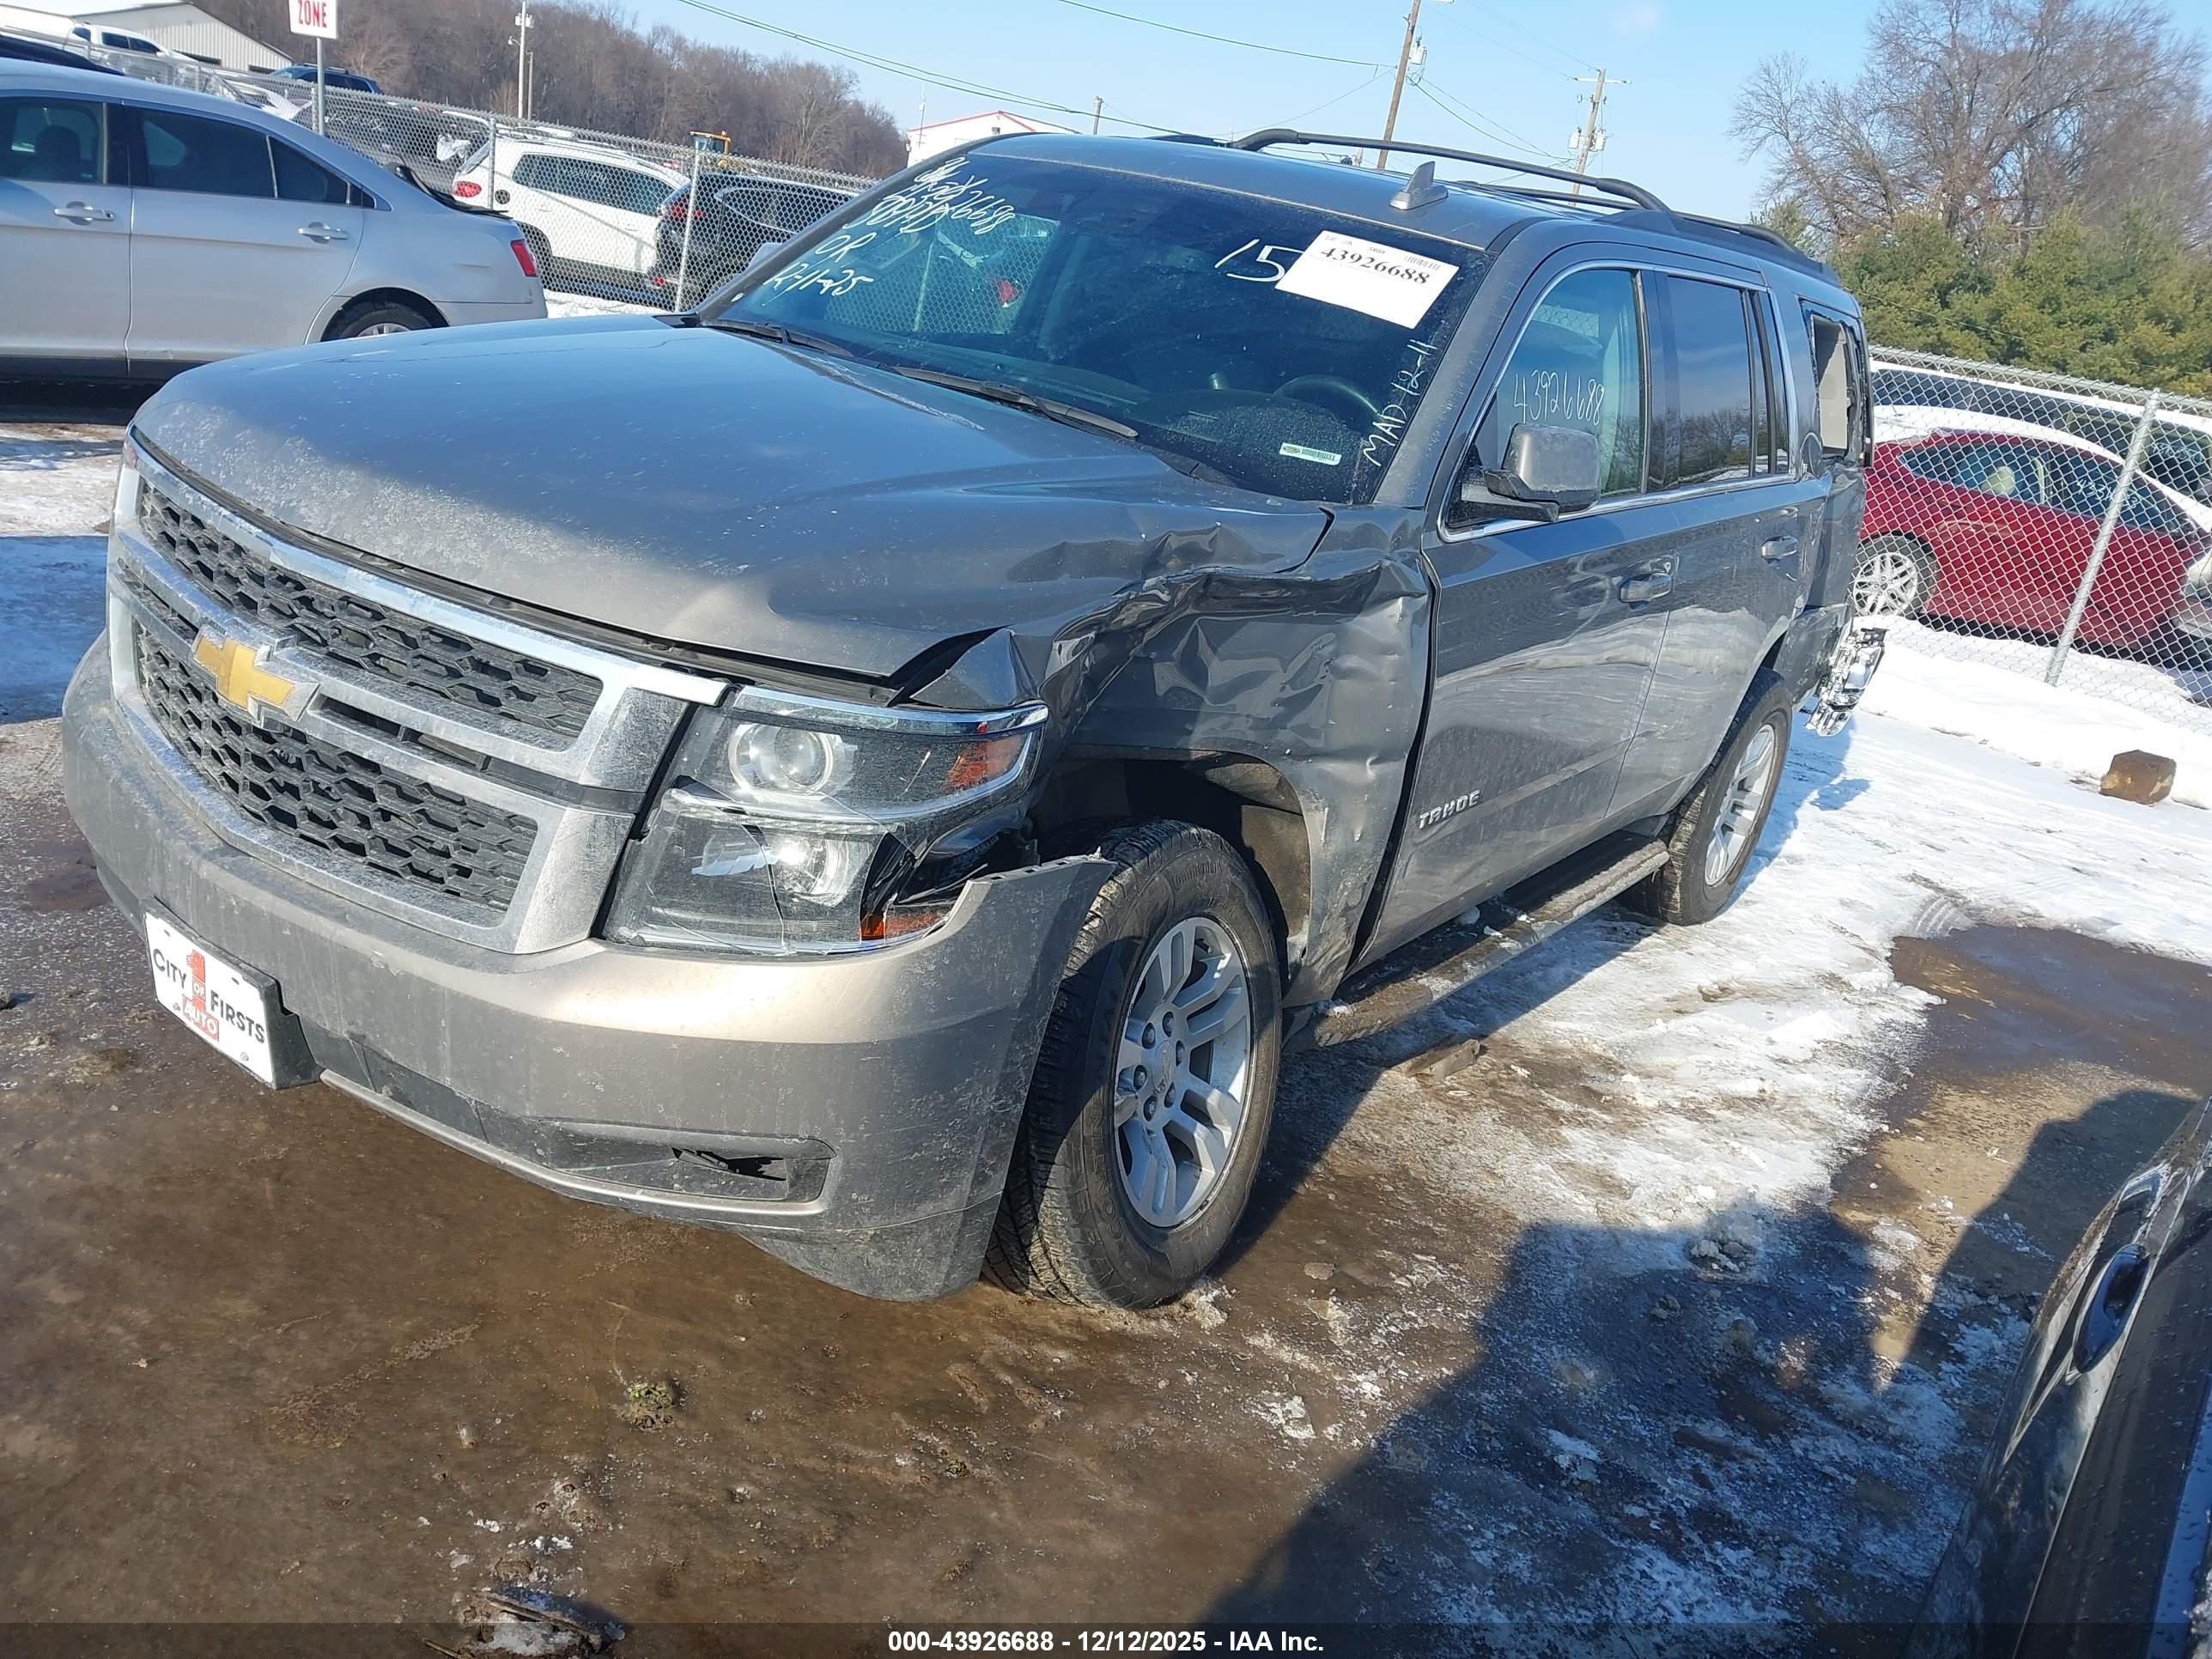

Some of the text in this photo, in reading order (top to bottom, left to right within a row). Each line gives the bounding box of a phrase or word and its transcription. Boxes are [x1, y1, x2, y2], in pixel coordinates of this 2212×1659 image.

[298, 0, 327, 28] ZONE
[1214, 239, 1304, 282] 15
[1321, 247, 1431, 285] 43926688
[1513, 369, 1605, 425] 43926688
[1363, 404, 1407, 466] MAD
[1419, 789, 1480, 830] TAHOE
[210, 988, 265, 1044] FIRSTS
